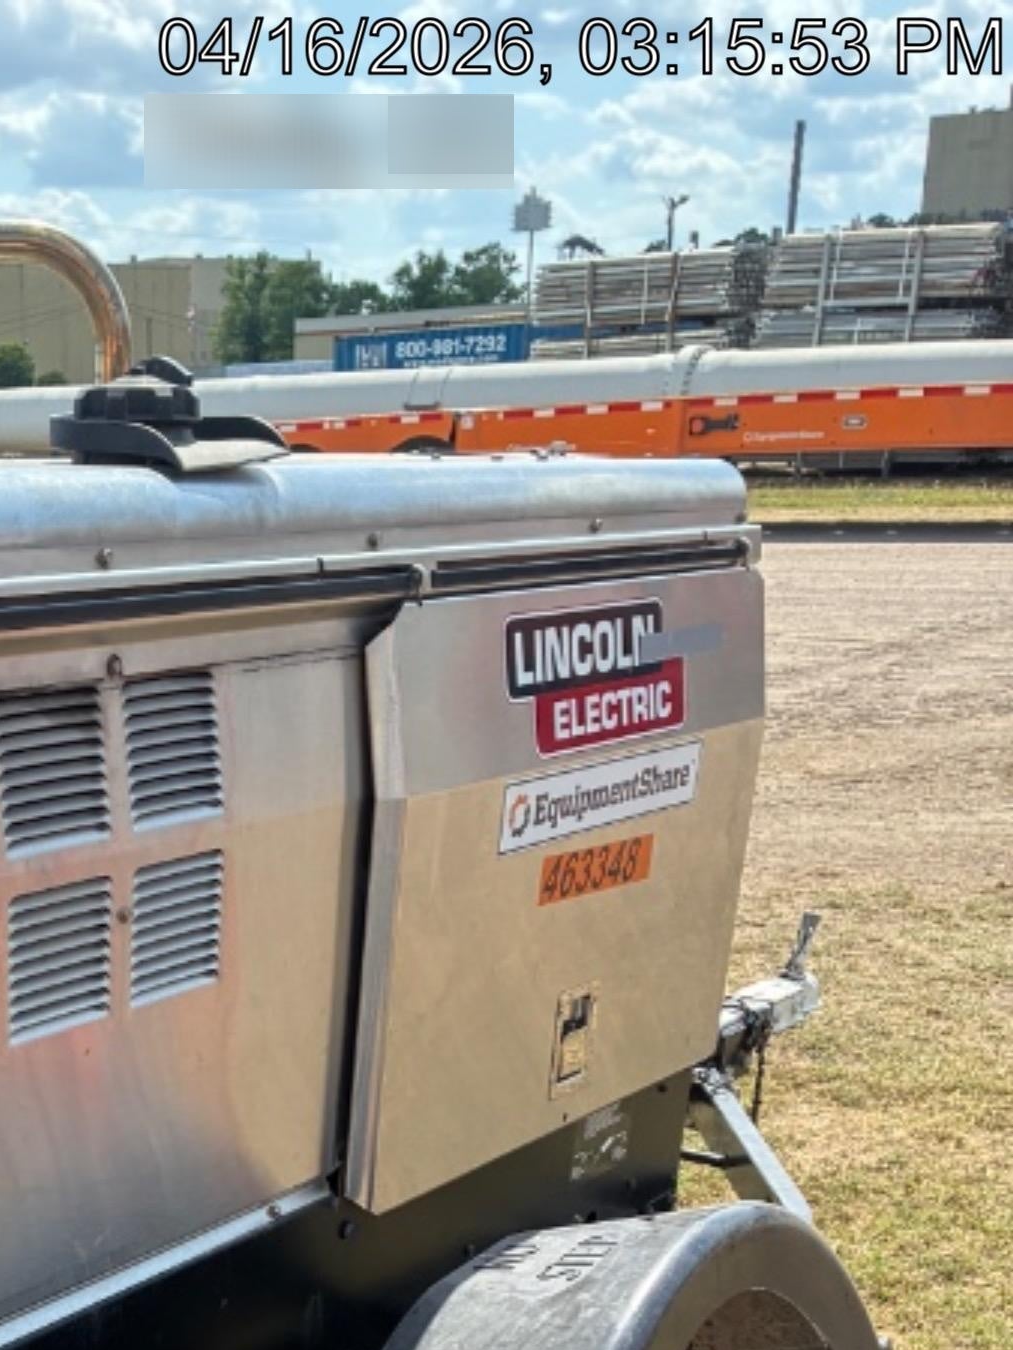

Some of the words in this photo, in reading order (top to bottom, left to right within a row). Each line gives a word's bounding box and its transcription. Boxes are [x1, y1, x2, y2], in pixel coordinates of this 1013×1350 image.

[553, 680, 673, 742] ELECTRIC
[532, 762, 692, 829] EquipmentShare
[541, 841, 642, 900] 463348
